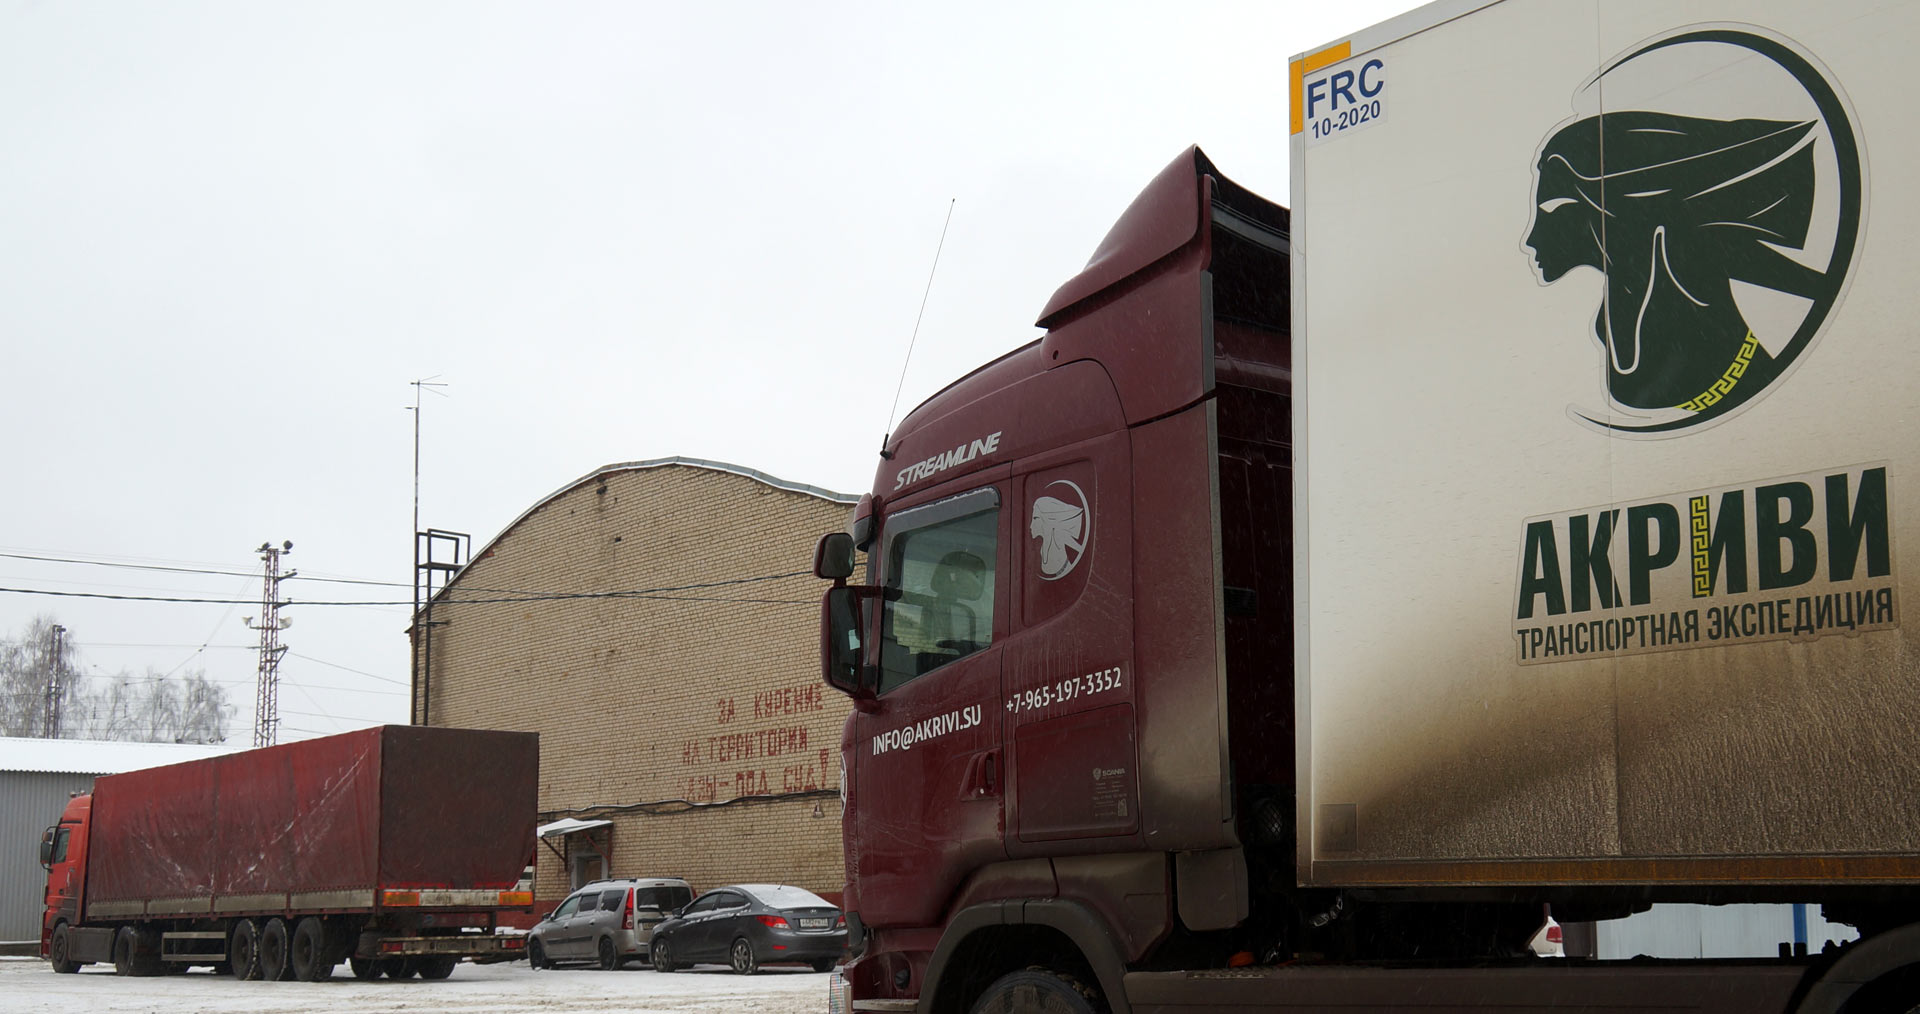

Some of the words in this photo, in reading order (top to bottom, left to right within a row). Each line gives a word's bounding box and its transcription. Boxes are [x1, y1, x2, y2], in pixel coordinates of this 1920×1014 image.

[1308, 59, 1384, 119] FRC
[1312, 100, 1380, 139] 10-2020
[894, 431, 1002, 491] STREAMLINE
[1517, 466, 1891, 619] АКРИВИ
[1517, 609, 1699, 660] ТРАНСПОРТНАЯ
[1707, 587, 1894, 640] ЭКСПЕДИЦИЯ
[754, 682, 823, 719] КУРЕНИЕ
[1006, 667, 1122, 714] +7-965-197-3352
[706, 725, 808, 762] ТЕРРИТОРИИ
[872, 704, 982, 756] INFO@AKRIVI.SU
